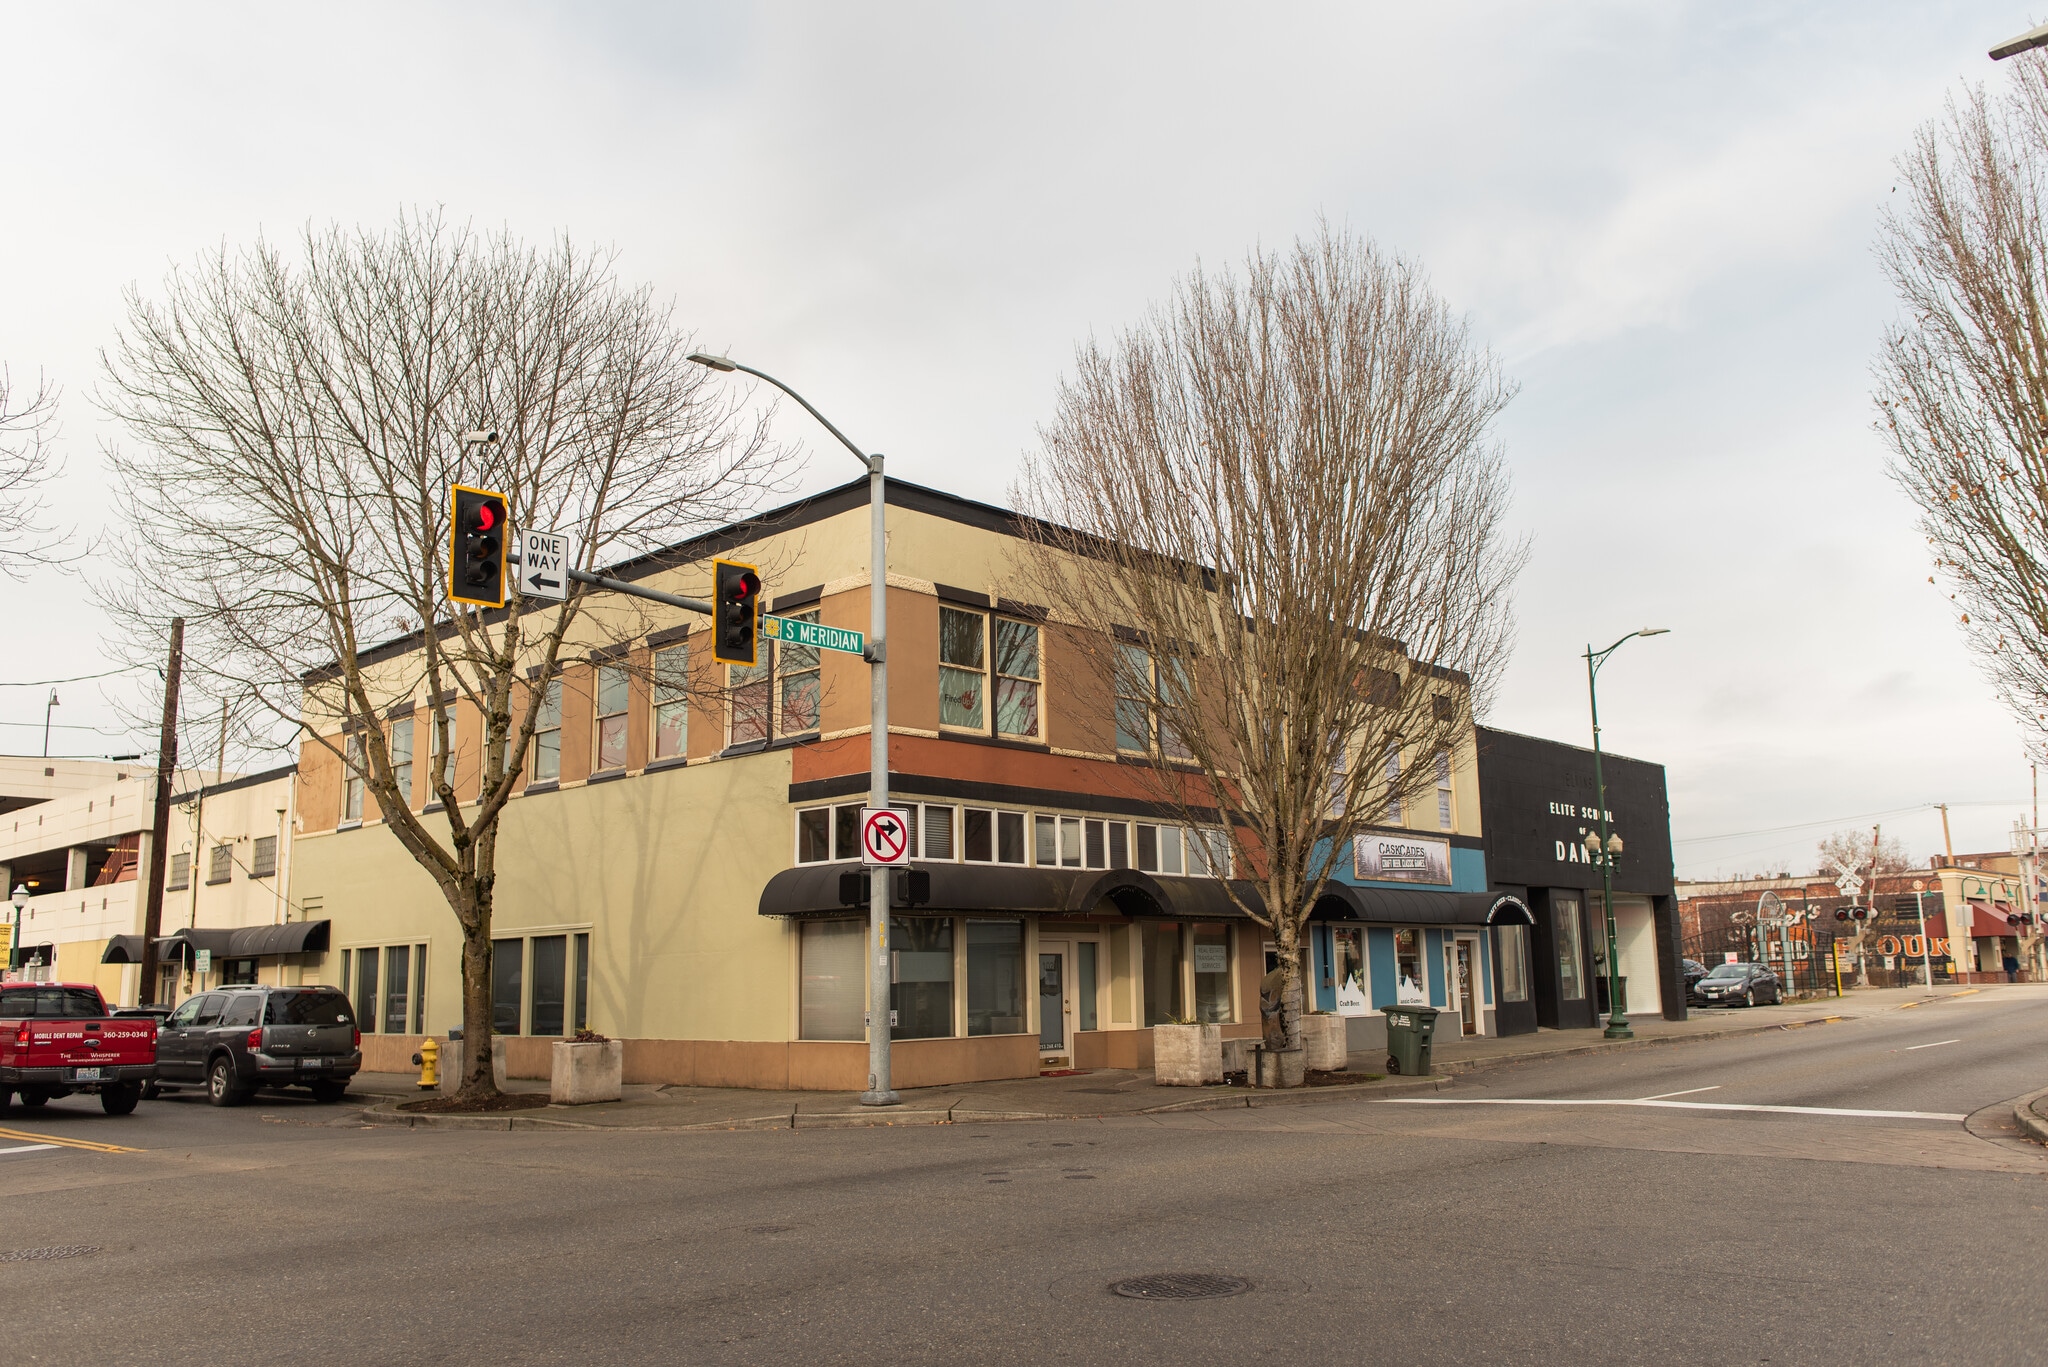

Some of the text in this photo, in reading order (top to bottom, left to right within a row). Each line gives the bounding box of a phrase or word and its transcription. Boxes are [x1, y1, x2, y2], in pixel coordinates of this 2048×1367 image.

[530, 536, 560, 555] ONE
[528, 552, 560, 571] WAY
[786, 622, 858, 651] S MERIDIAN
[1550, 801, 1576, 817] ELITE
[103, 1031, 148, 1039] 360-259-0348
